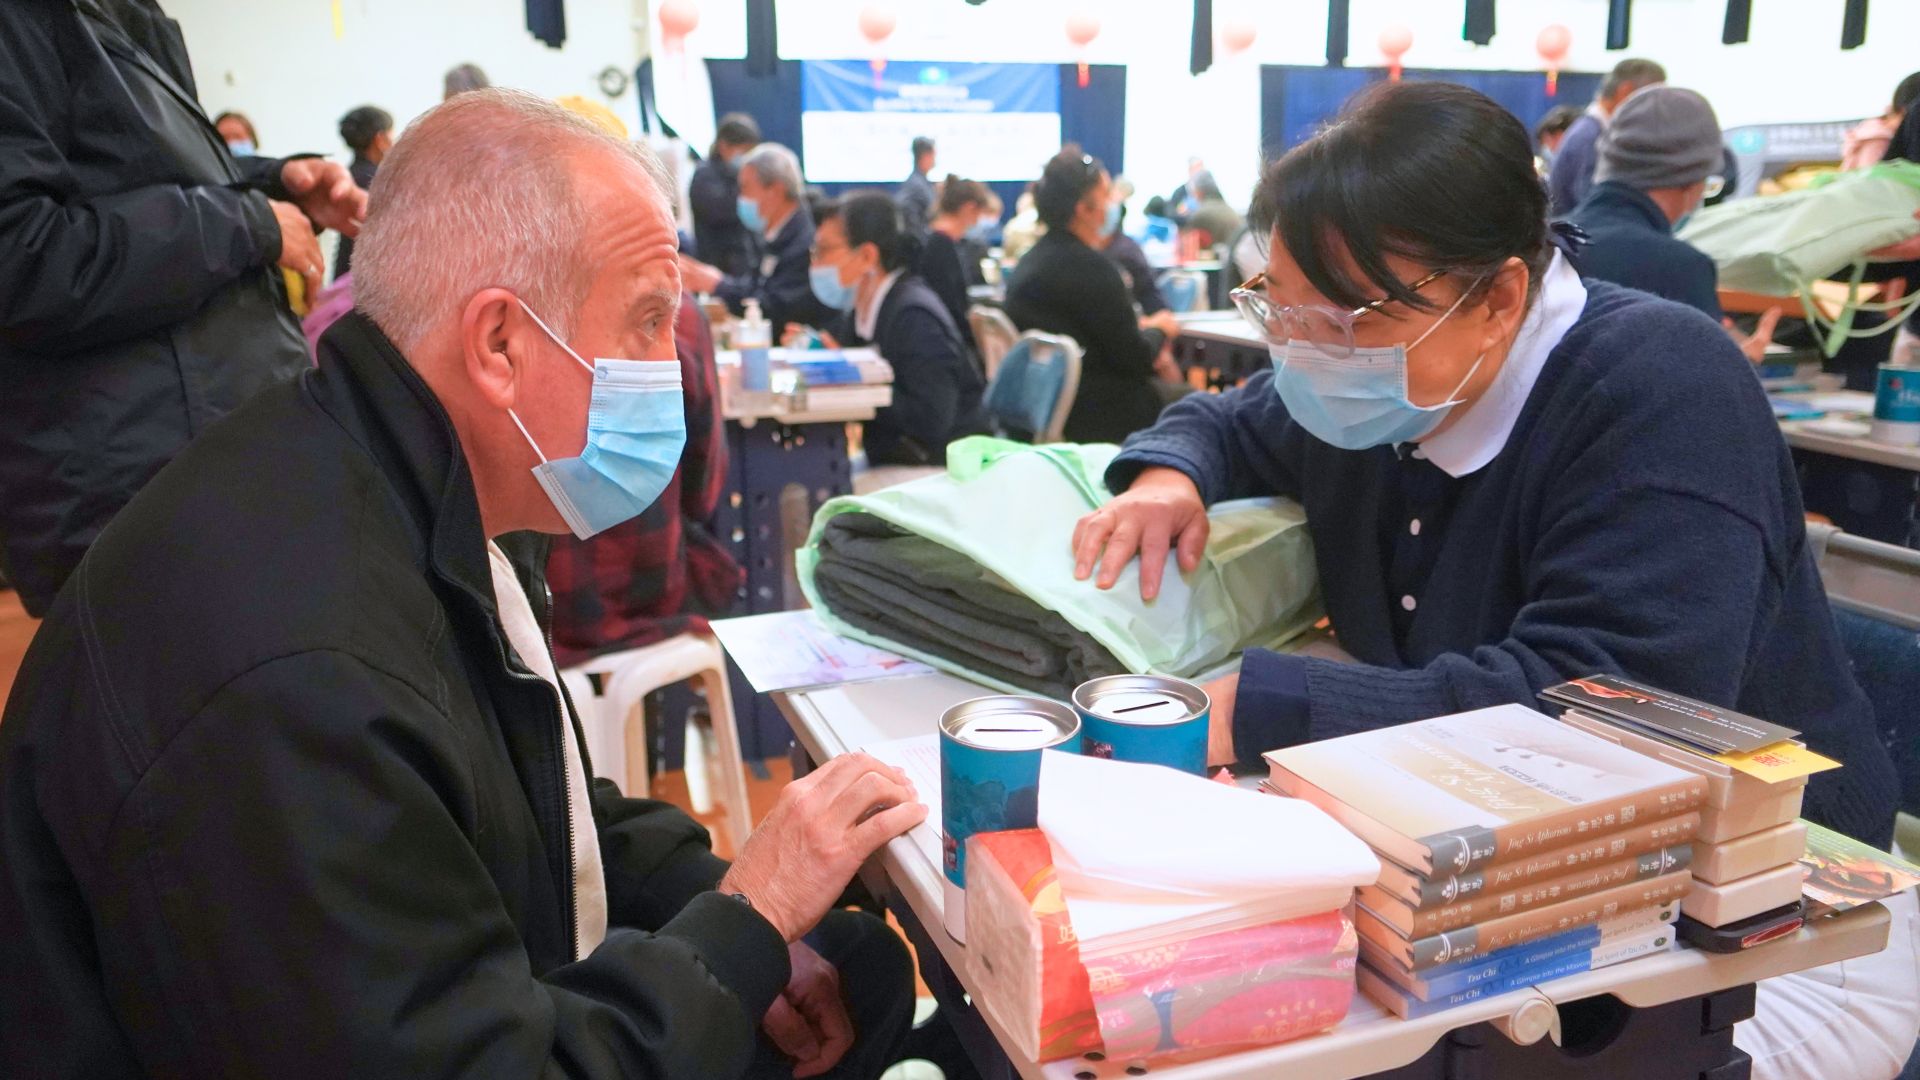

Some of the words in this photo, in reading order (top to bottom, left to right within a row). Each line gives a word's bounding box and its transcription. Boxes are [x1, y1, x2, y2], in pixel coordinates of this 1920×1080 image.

[1505, 838, 1525, 855] Jing
[1527, 833, 1535, 844] Si
[1495, 871, 1512, 886] Jing
[1515, 866, 1523, 877] Si
[1555, 946, 1566, 955] into
[1467, 973, 1481, 983] Tzu
[1482, 967, 1497, 979] Chi
[1516, 974, 1541, 984] Glimpse
[1542, 968, 1554, 977] into
[1555, 966, 1566, 975] the
[1450, 991, 1465, 1004] Tzu
[1466, 988, 1480, 1000] Chi
